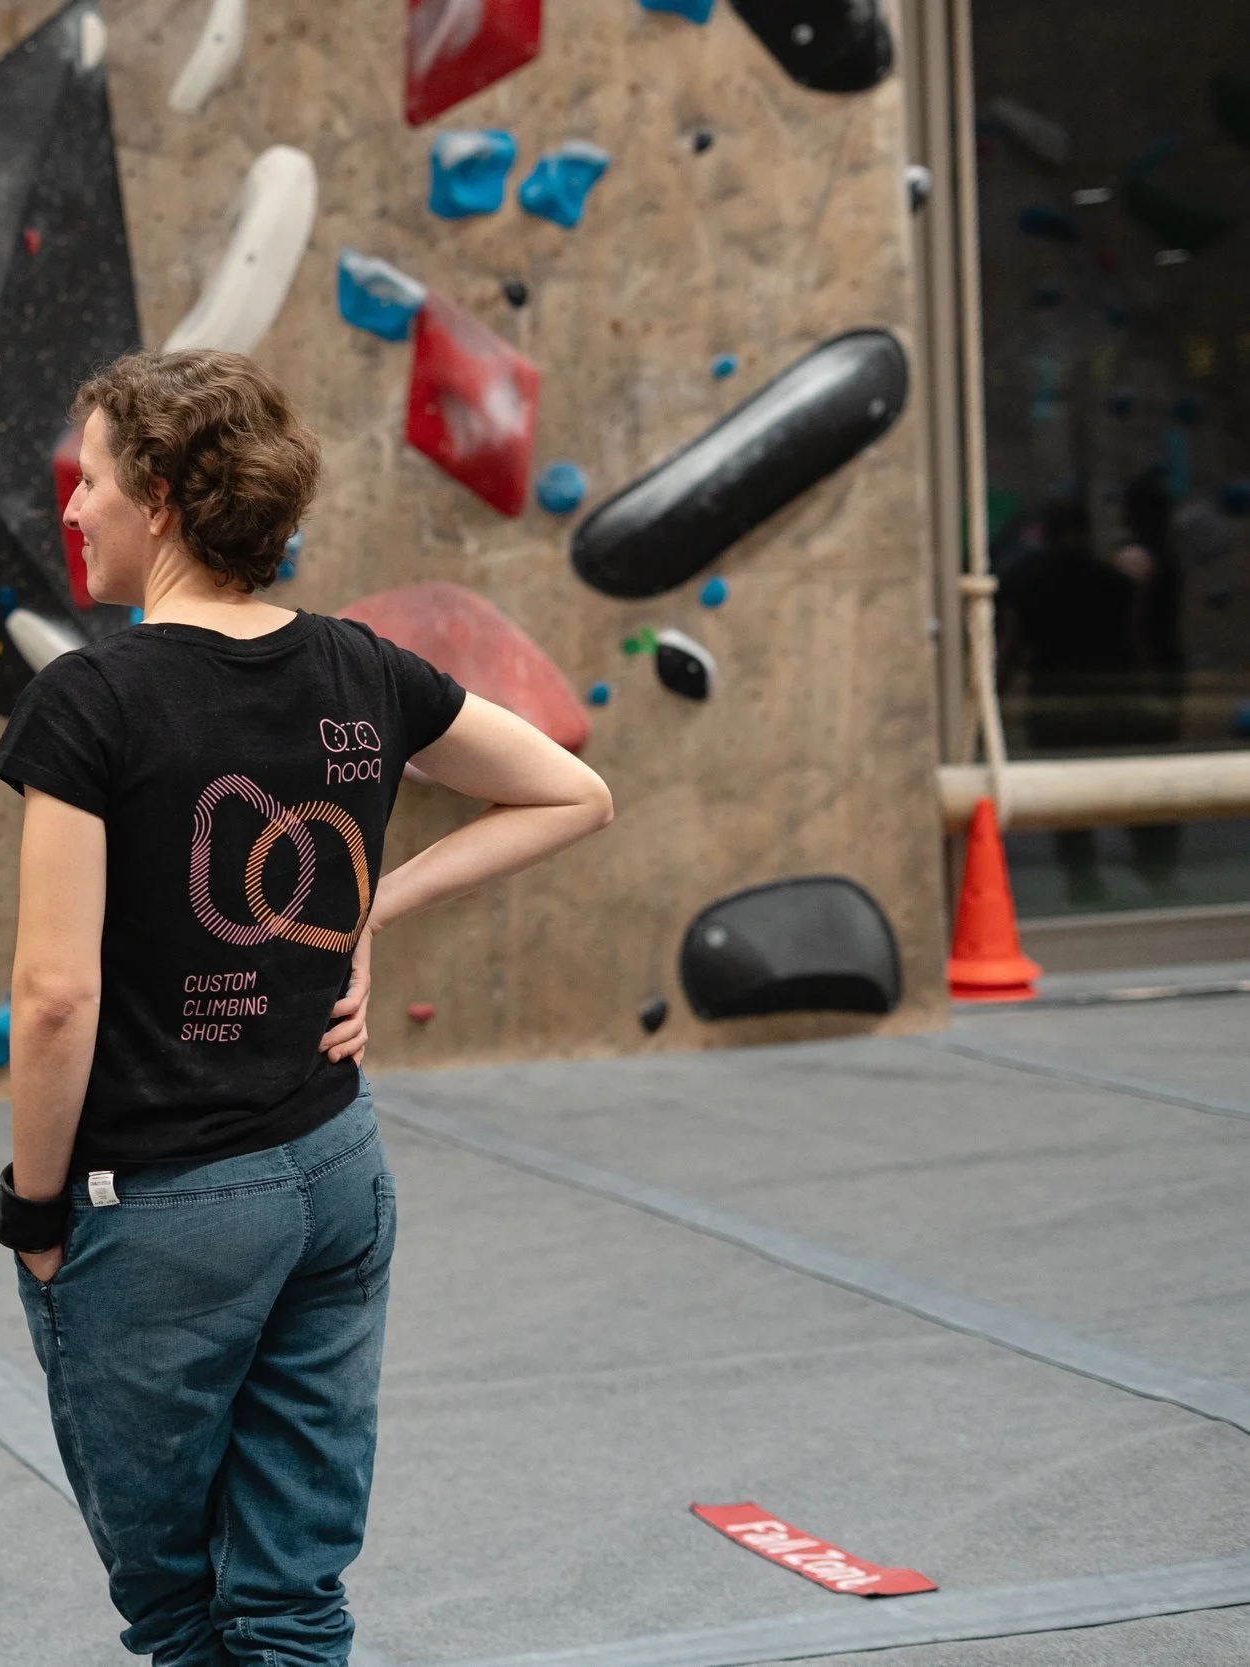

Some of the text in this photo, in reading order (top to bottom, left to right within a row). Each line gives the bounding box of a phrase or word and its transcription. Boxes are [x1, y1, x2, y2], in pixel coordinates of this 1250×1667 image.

[326, 758, 382, 785] hooq
[184, 971, 257, 993] CUSTOM
[182, 995, 268, 1017] CLIMBING
[180, 1023, 242, 1042] SHOES
